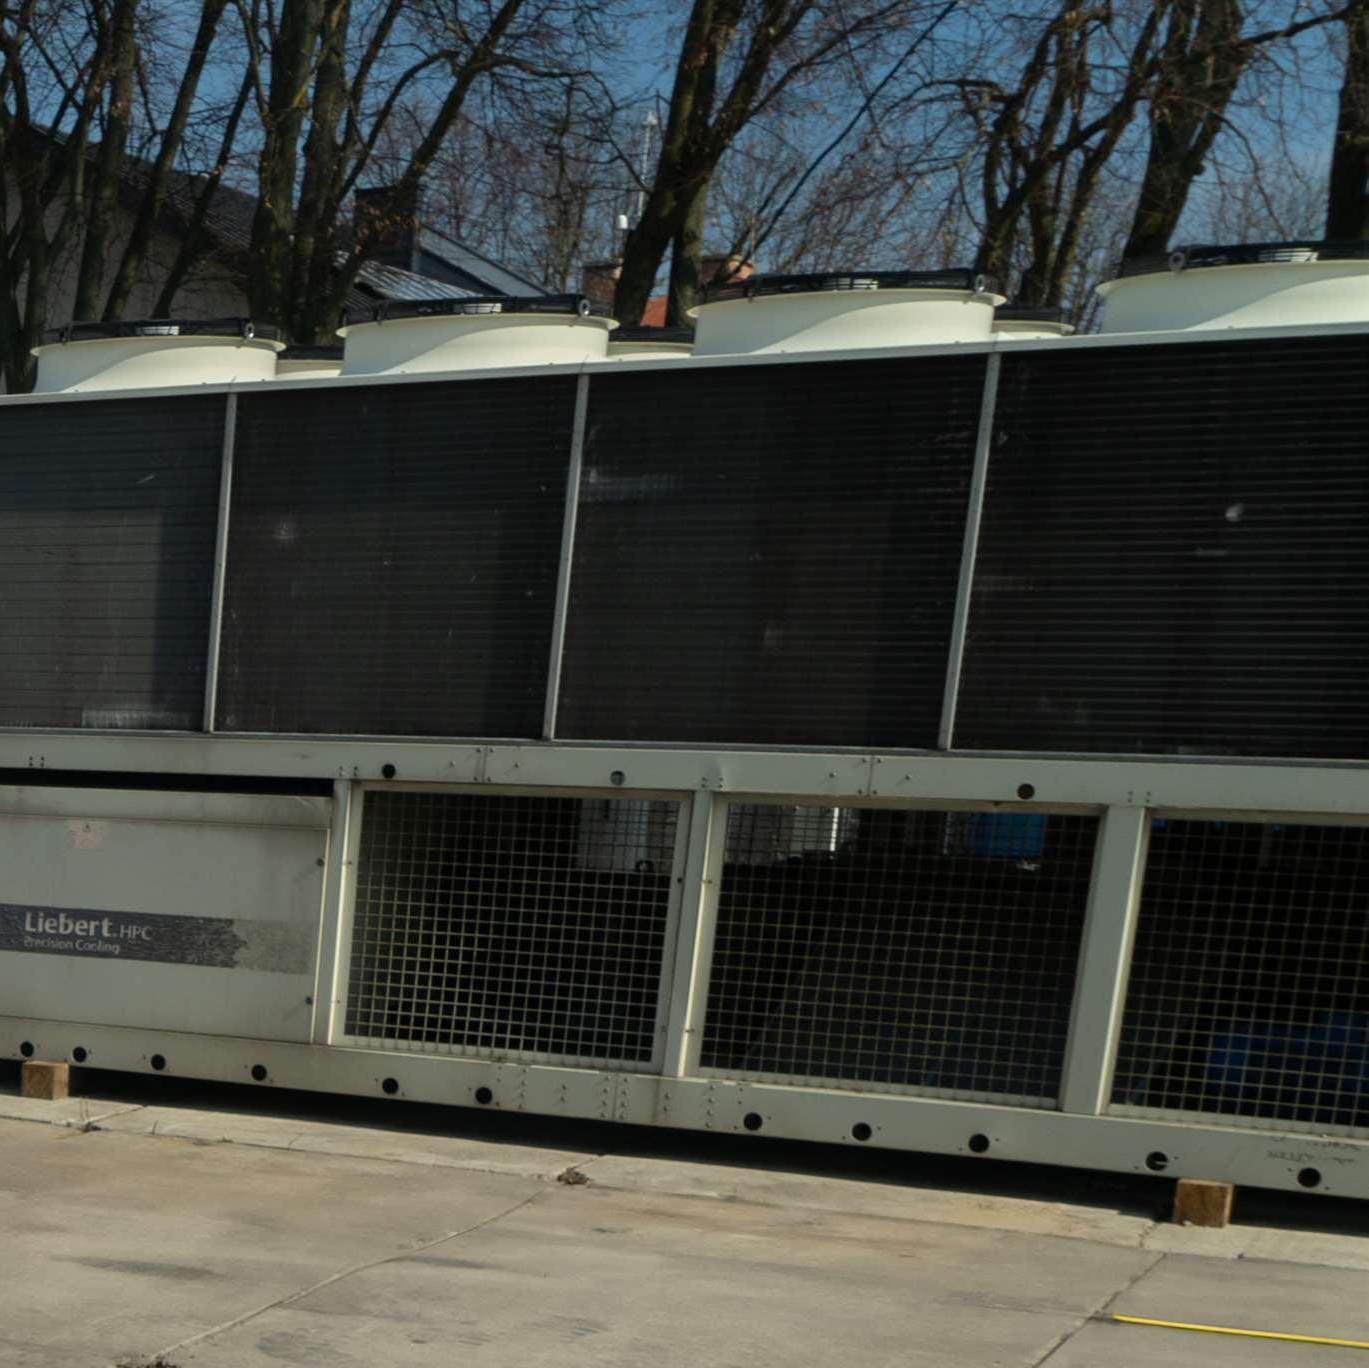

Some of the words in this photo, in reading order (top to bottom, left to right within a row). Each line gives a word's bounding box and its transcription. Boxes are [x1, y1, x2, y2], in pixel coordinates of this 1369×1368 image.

[24, 911, 113, 937] Liebert
[119, 924, 153, 940] HPC
[23, 935, 74, 950] Precision
[75, 939, 120, 954] Cooling
